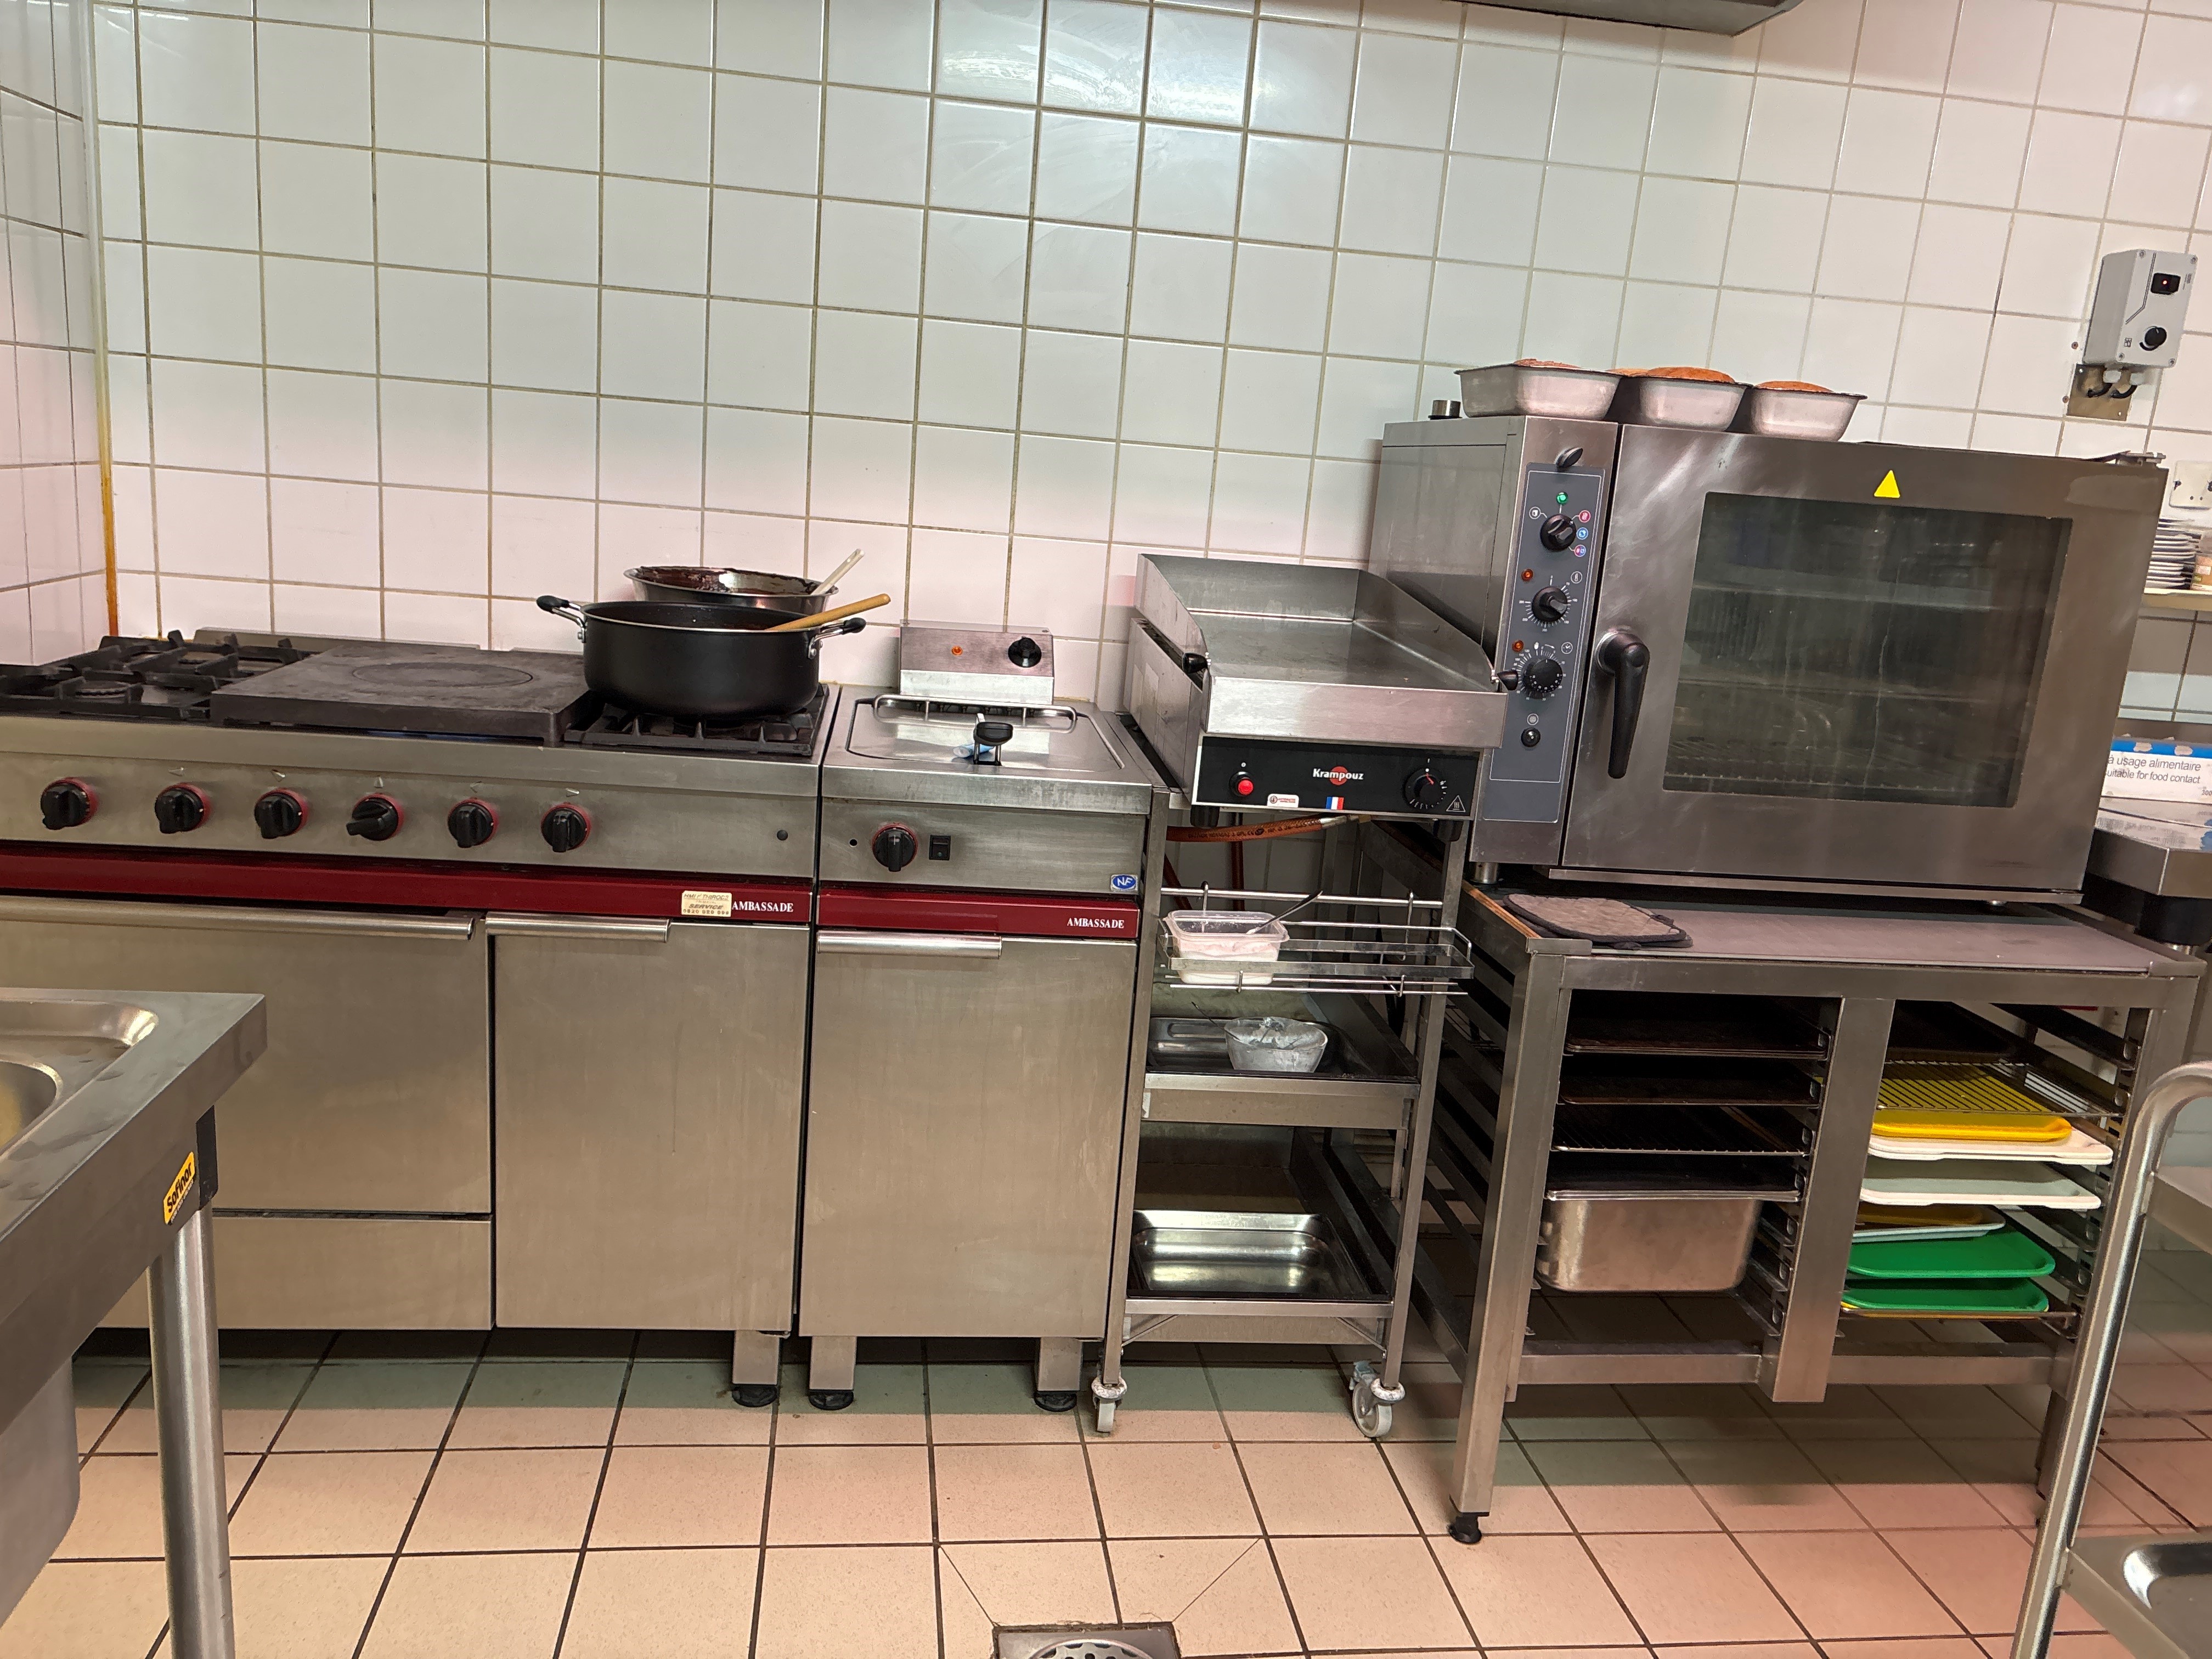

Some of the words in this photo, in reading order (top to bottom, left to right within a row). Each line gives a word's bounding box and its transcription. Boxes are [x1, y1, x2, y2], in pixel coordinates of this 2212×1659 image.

[2117, 757, 2147, 769] usage
[2149, 759, 2201, 771] alimentaire
[1313, 768, 1364, 781] Krampouz
[2107, 769, 2135, 778] uitable
[2137, 770, 2148, 780] for
[2150, 771, 2169, 781] food
[2170, 775, 2200, 784] contact
[1117, 877, 1133, 887] NF
[732, 901, 794, 912] AMBASSADE
[1067, 918, 1125, 929] AMBASSADE
[167, 1162, 192, 1214] Sofinor
